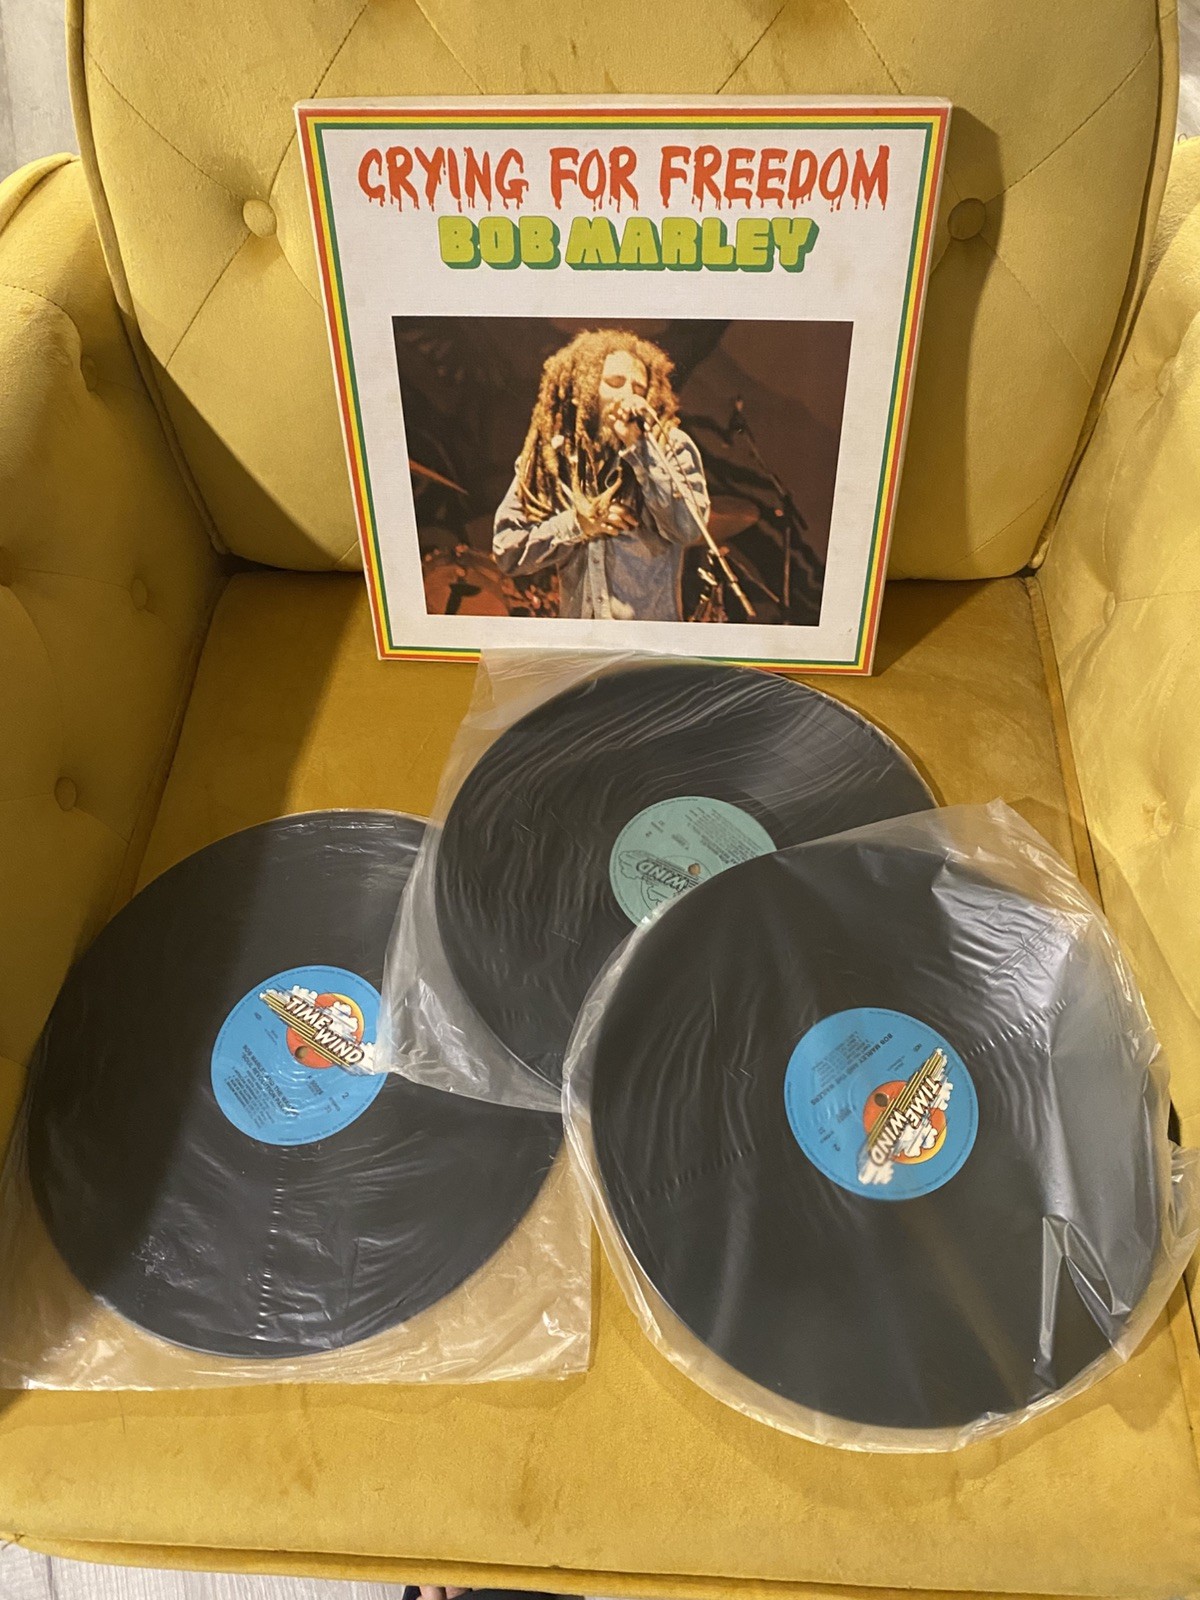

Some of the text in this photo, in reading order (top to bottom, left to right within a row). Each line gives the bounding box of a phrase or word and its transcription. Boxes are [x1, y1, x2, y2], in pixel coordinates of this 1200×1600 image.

[358, 145, 890, 212] CRYING FOR FREEDOM
[438, 216, 818, 272] BOB MARLEY
[857, 1042, 881, 1064] MARLEY
[879, 1032, 893, 1045] BOB
